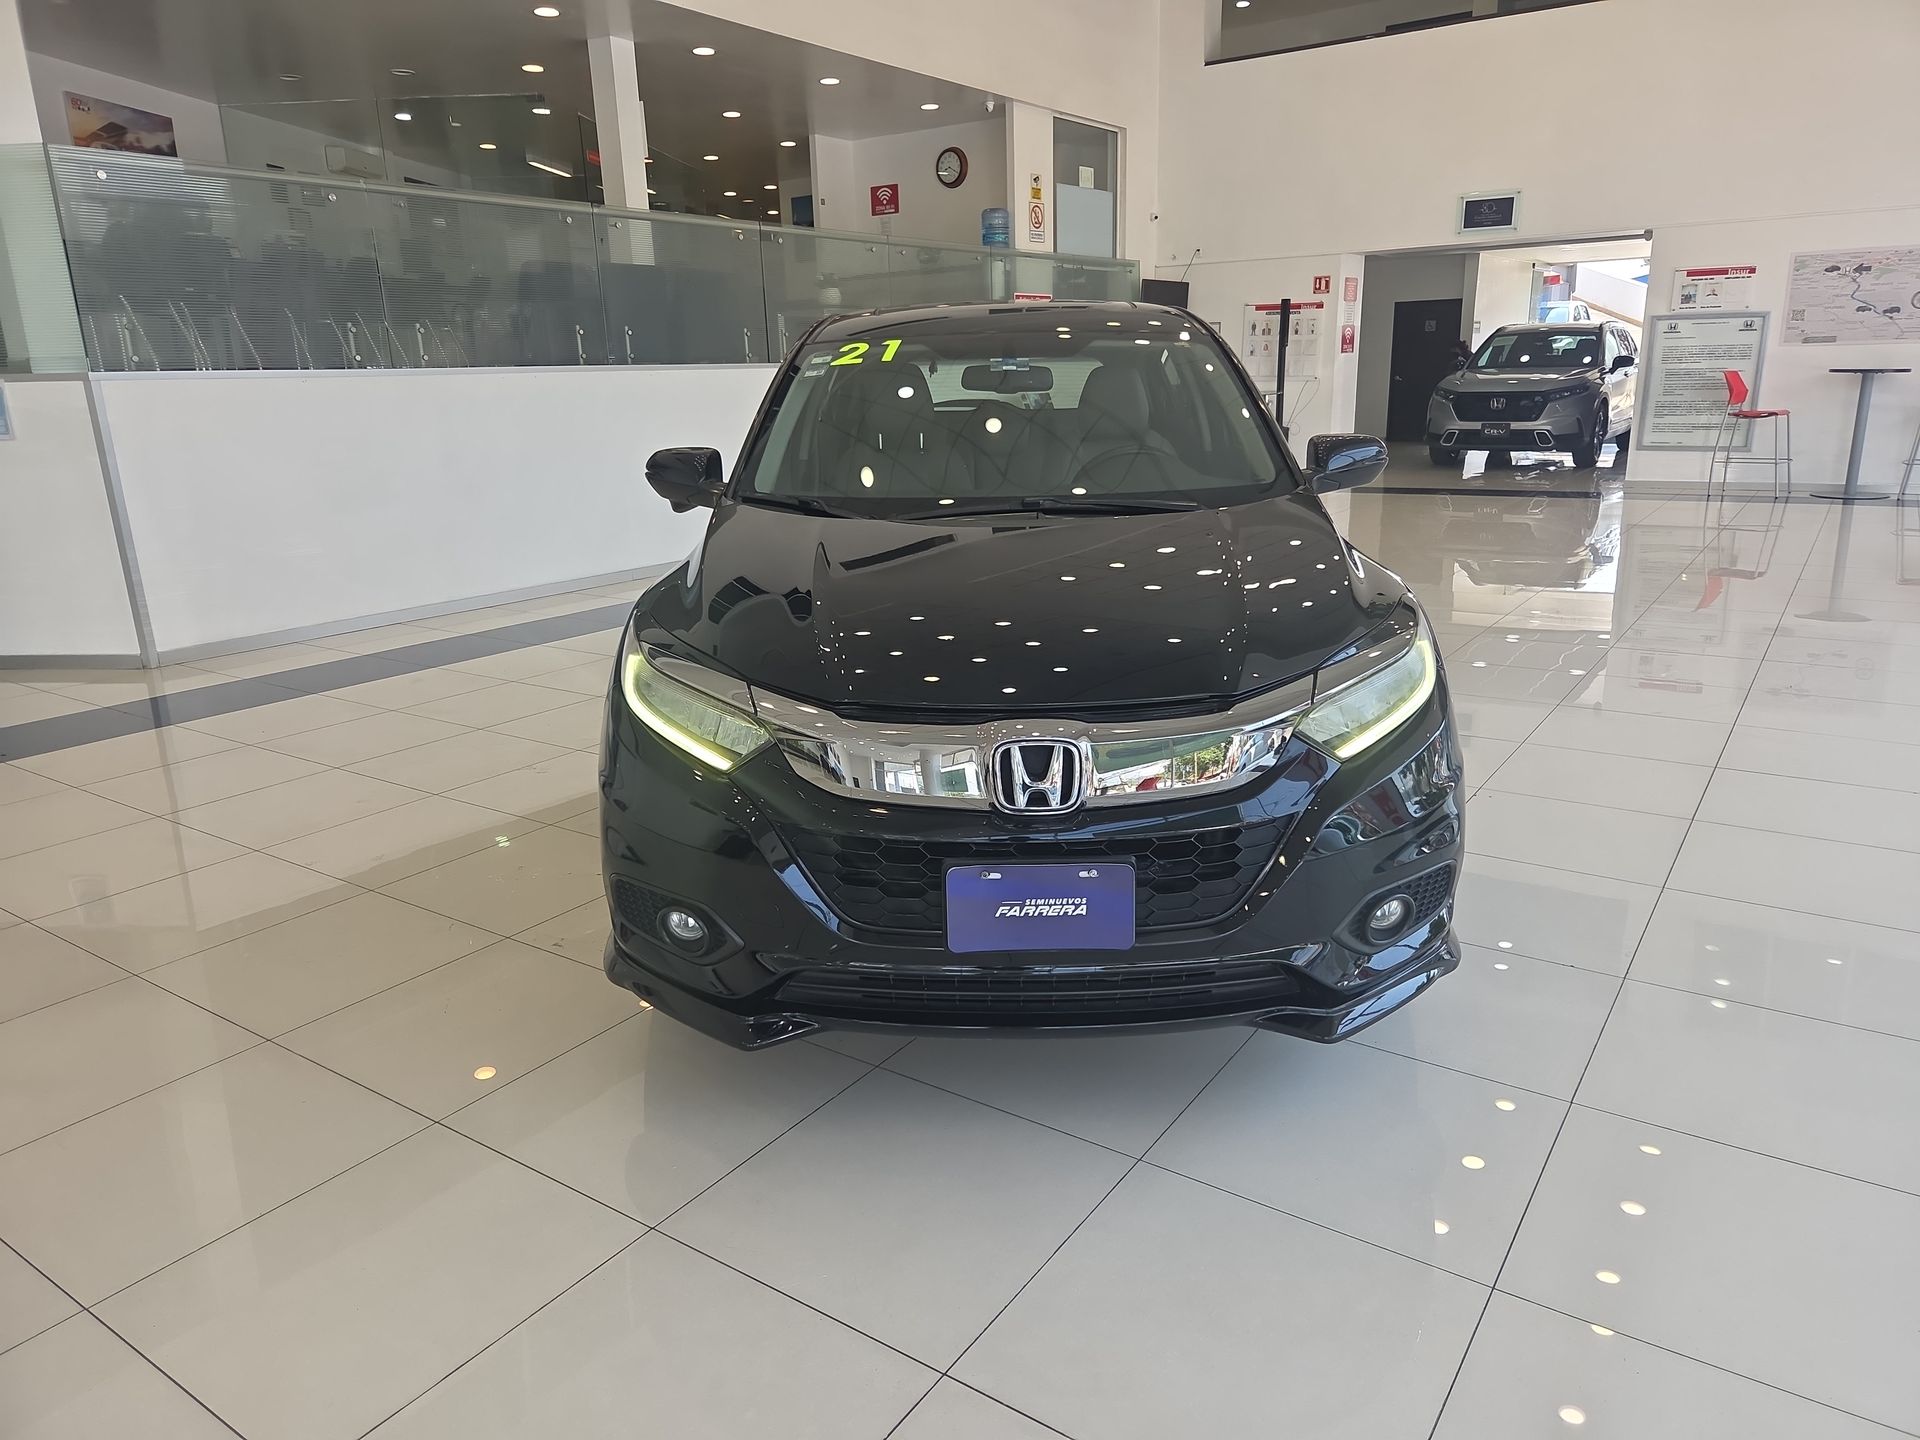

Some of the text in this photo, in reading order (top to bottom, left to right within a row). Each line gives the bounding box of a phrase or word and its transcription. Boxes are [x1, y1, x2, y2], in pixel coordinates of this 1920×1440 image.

[829, 338, 903, 366] 21
[1025, 897, 1088, 906] SEMINUEVOS
[994, 904, 1088, 918] FARRERA
